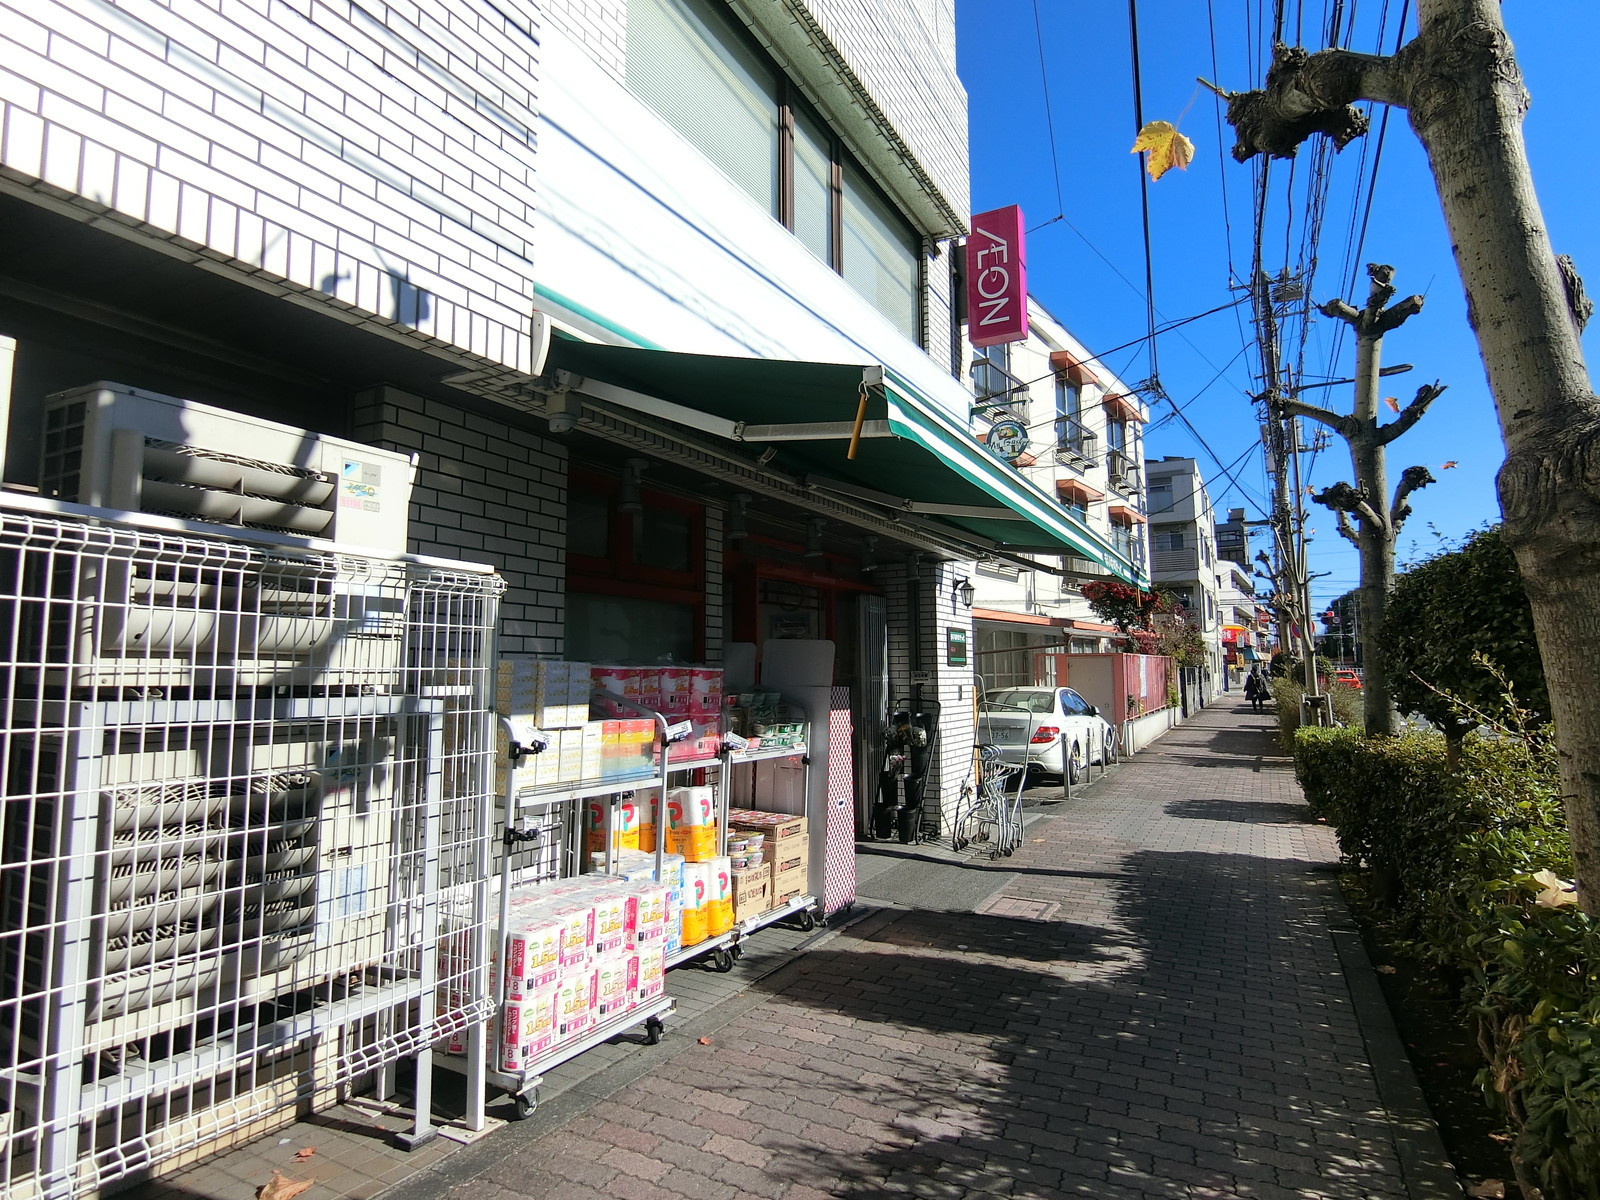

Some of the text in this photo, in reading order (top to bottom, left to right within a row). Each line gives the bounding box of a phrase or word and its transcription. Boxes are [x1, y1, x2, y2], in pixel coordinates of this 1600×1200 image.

[976, 228, 1009, 326] AEON
[676, 844, 684, 853] 12
[512, 981, 518, 991] 8
[508, 1050, 513, 1058] 8
